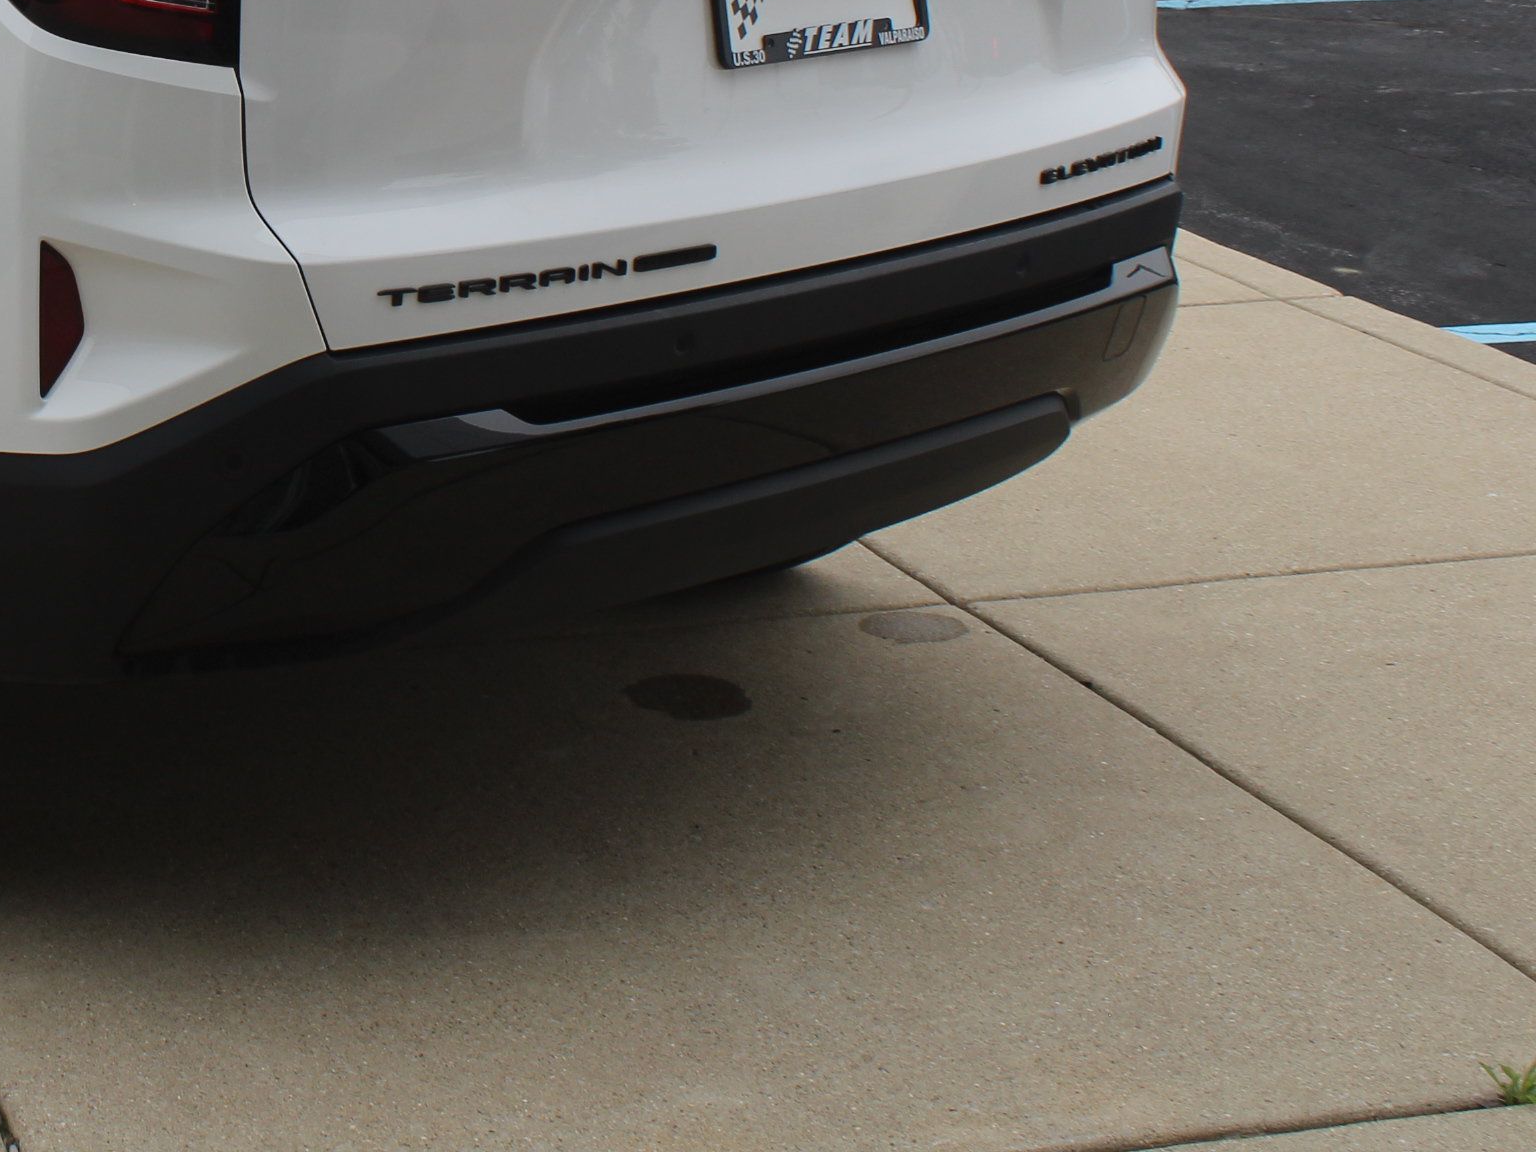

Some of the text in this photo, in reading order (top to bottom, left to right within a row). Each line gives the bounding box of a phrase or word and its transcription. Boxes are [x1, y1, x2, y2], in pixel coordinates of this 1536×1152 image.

[803, 19, 874, 55] TEAM
[878, 27, 926, 46] VALPARAISO
[376, 258, 628, 307] TERRAIN
